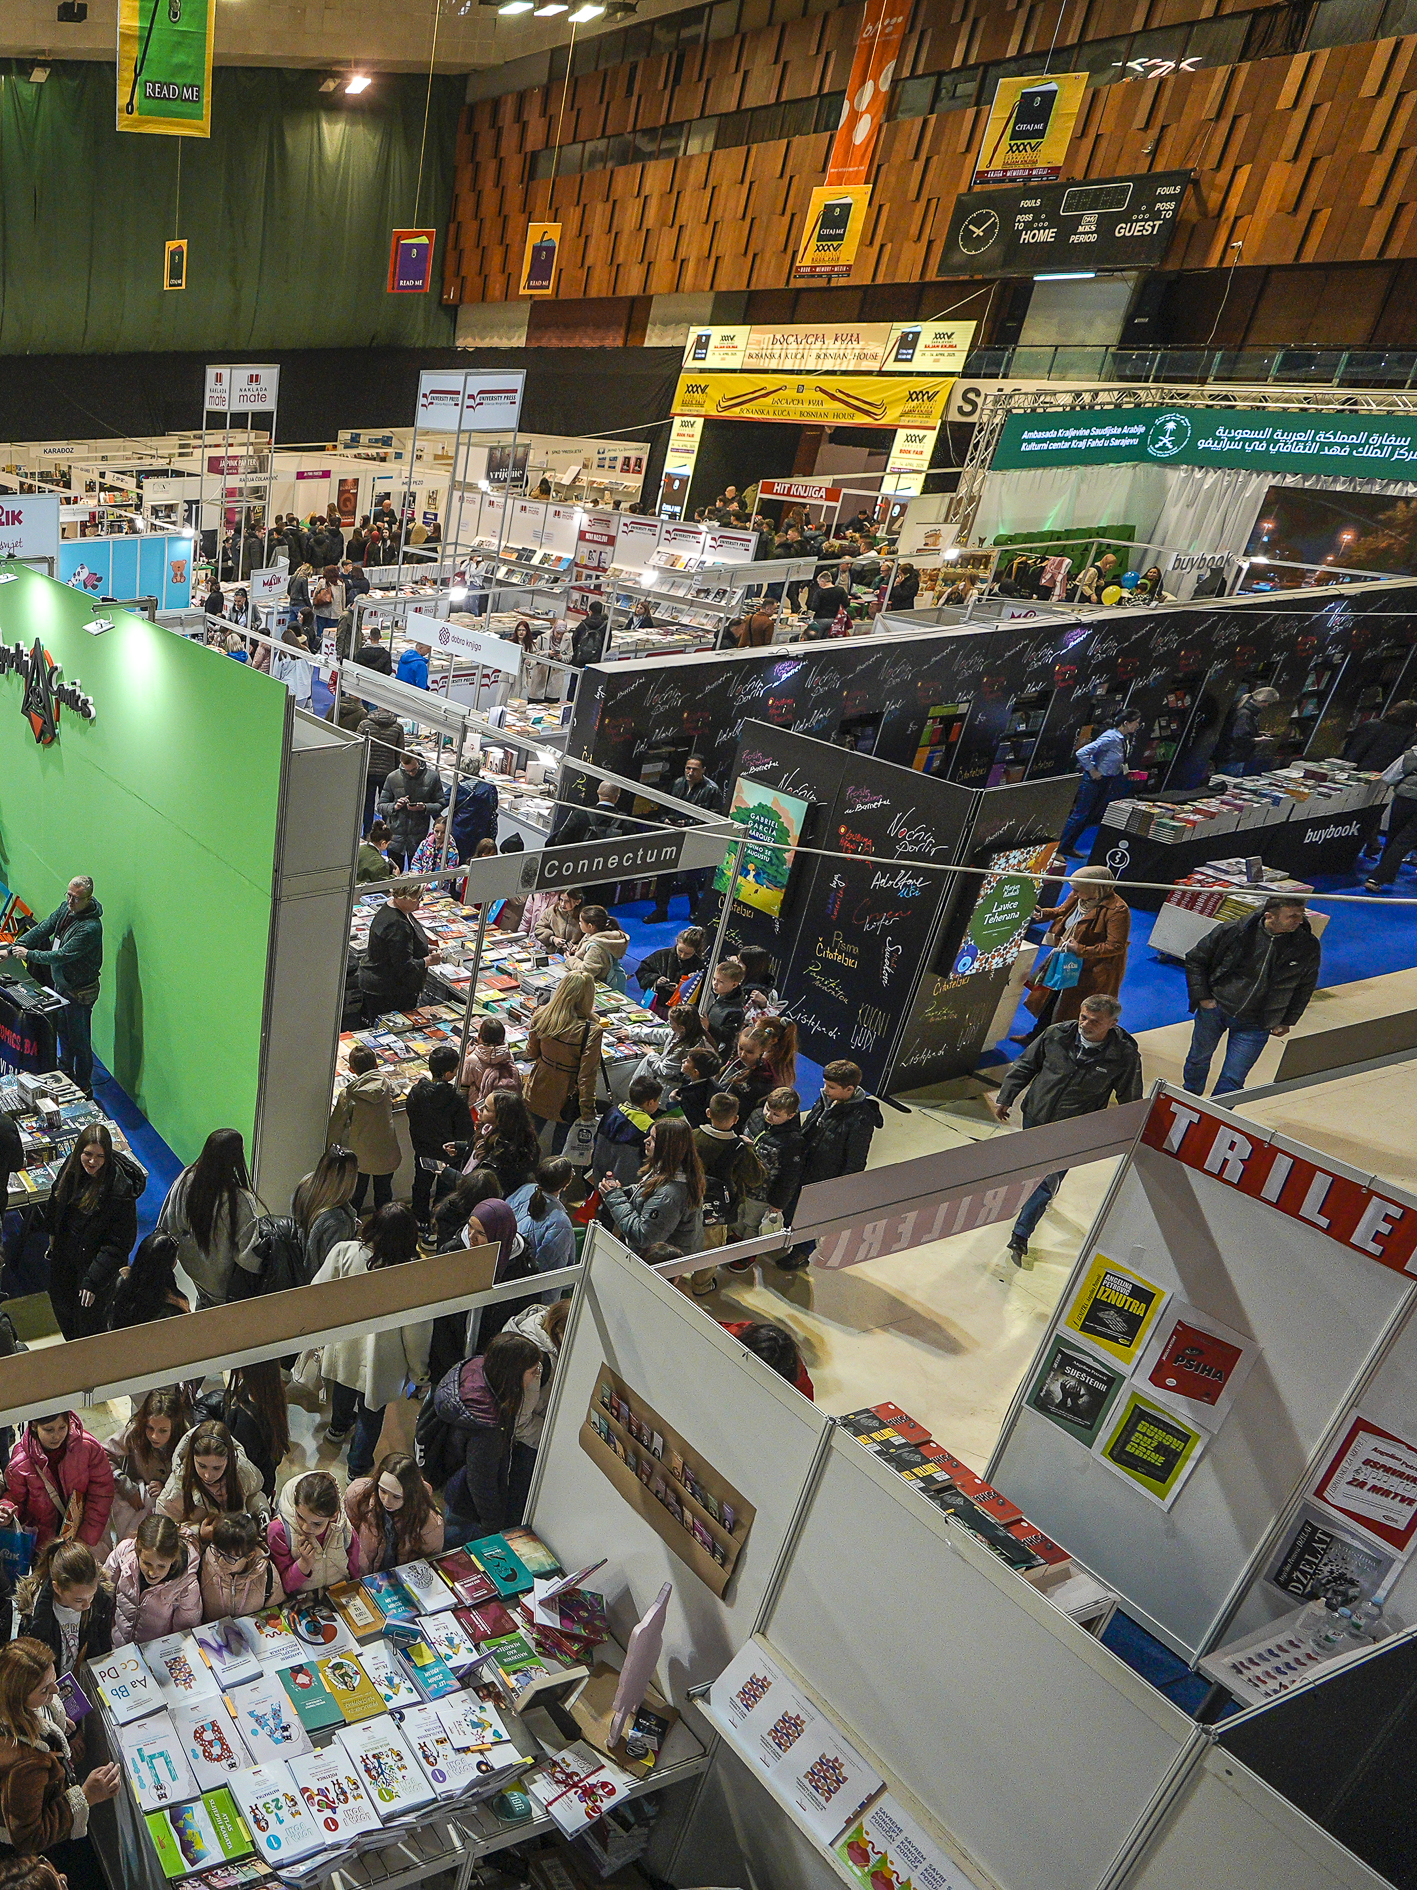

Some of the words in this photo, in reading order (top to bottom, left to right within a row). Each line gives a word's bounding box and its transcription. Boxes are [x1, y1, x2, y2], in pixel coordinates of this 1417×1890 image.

[144, 81, 180, 100] READ
[181, 86, 200, 102] ME
[1015, 122, 1035, 132] ČITAJ
[1033, 122, 1045, 131] ME
[1155, 185, 1182, 196] FOULS
[1019, 198, 1042, 208] FOULS
[1154, 201, 1176, 212] POSS
[1015, 213, 1034, 223] POSS
[1160, 210, 1174, 220] TO
[819, 227, 838, 236] ČITAJ
[1014, 222, 1025, 231] TO
[1076, 224, 1097, 233] MKS
[1114, 220, 1164, 238] GUEST
[1019, 228, 1058, 244] HOME
[1068, 233, 1098, 244] PERIOD
[746, 351, 783, 362] BOSANSKA
[784, 350, 806, 362] KUĆA
[814, 351, 849, 361] BOSNIAN
[851, 351, 880, 362] HOUSE
[207, 394, 227, 408] mate
[238, 390, 268, 405] mate
[429, 394, 449, 403] UNIVERSITY
[448, 395, 461, 403] PRESS
[478, 394, 503, 403] UNIVERSITY
[502, 394, 517, 402] PRESS
[738, 407, 771, 418] BOSANSKA
[772, 408, 791, 417] KUĆA
[798, 410, 829, 420] BOSNIAN
[832, 411, 857, 421] HOUSE
[1021, 428, 1057, 441] Ambasada
[1056, 427, 1090, 439] Kraljevine
[1089, 426, 1122, 438] Saudijske
[1121, 424, 1146, 437] Arabije
[1214, 426, 1273, 439] السعودية
[1271, 428, 1316, 442] العربية
[1315, 430, 1372, 443] المملكة
[1371, 432, 1415, 445] سفارة
[898, 448, 913, 456] BOOK
[912, 448, 924, 456] FAIR
[1020, 439, 1049, 452] Kulturni
[1049, 439, 1071, 450] centar
[1070, 438, 1089, 450] Kralj
[1087, 438, 1104, 449] Fahd
[1109, 437, 1139, 449] Sarajevu
[1196, 438, 1245, 451] سراييفو
[1244, 440, 1269, 452] في
[1268, 440, 1319, 454] الثقافي
[772, 482, 790, 495] HIT
[789, 483, 827, 499] KNJIGA
[718, 539, 739, 548] UNIVERSITY
[738, 540, 751, 549] PRESS
[1171, 551, 1235, 574] buybook
[449, 633, 466, 646] dobra
[465, 637, 483, 652] knjiga
[747, 820, 778, 837] GARCÍA
[749, 812, 780, 830] GABRIEL
[1302, 820, 1361, 845] buybook
[746, 848, 771, 863] AUGUSTU
[764, 848, 772, 857] SE
[542, 844, 679, 880] Connectum
[991, 899, 1019, 913] Lavice
[983, 909, 1021, 926] Teherana
[1161, 1100, 1417, 1276] TRILE
[1101, 1279, 1132, 1297] PETROVIĆ
[1104, 1273, 1133, 1291] ANGELINA
[1095, 1285, 1148, 1318] IZNUTRA
[1171, 1353, 1225, 1385] PSIHA
[1370, 1446, 1403, 1463] Angelina
[1345, 1476, 1369, 1491] ZA
[1366, 1484, 1417, 1508] MRTVE
[1287, 1528, 1333, 1597] DŽELAT
[120, 1657, 140, 1672] Cc
[97, 1665, 121, 1684] Dd
[131, 1675, 149, 1690] Aa
[109, 1683, 131, 1700] Bb
[511, 1792, 525, 1811] JBL
[220, 1811, 235, 1833] ATLAS
[873, 1809, 901, 1839] KONCEPT
[218, 1824, 234, 1851] KARATA
[899, 1839, 924, 1865] KONCEP
[902, 1835, 927, 1862] SAVREM
[895, 1843, 920, 1871] PODUČA
